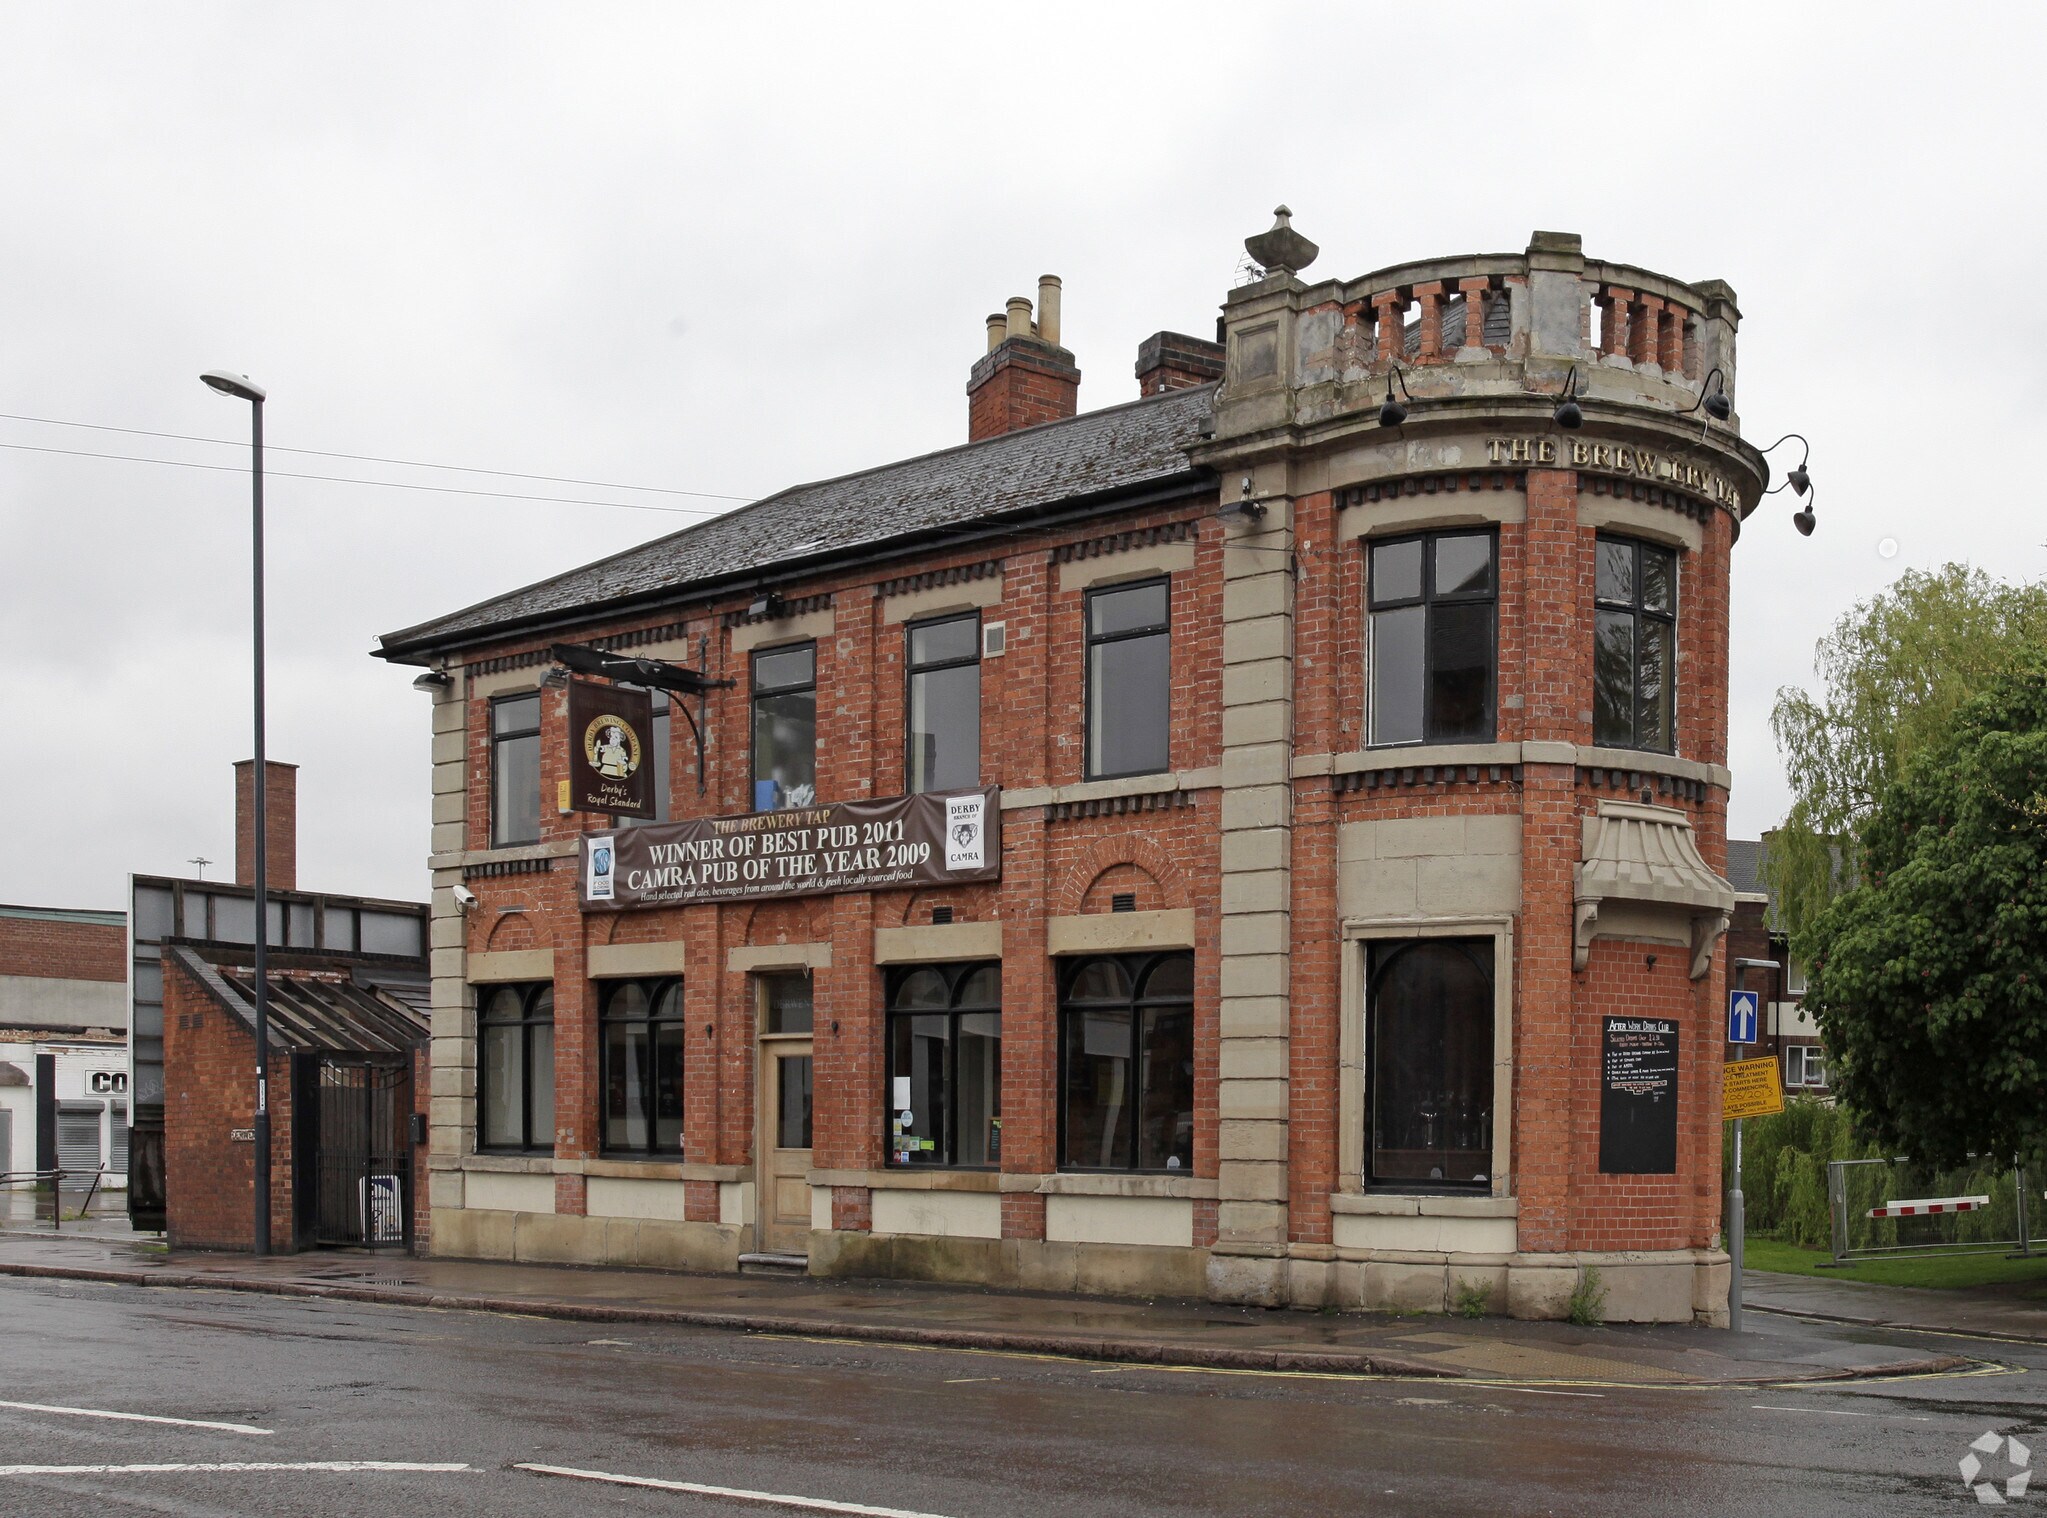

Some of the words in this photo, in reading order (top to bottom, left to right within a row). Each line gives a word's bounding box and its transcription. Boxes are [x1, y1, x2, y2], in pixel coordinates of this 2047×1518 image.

[1488, 438, 1555, 464] THE
[601, 783, 627, 797] Derby's
[587, 793, 608, 807] Royal
[609, 796, 642, 809] Standard
[951, 803, 980, 814] DERBY
[713, 820, 737, 834] THE
[741, 812, 803, 832] BREWERY
[806, 809, 830, 825] TAP
[649, 838, 723, 865] WINNER
[729, 835, 756, 858] OF
[761, 829, 811, 855] BEST
[816, 825, 857, 850] PUB
[863, 819, 905, 845] 2011
[951, 852, 979, 862] CAMRA
[627, 866, 697, 890] CAMRA
[702, 861, 738, 884] PUB
[743, 858, 770, 880] OF
[775, 853, 818, 878] THE
[823, 848, 881, 874] YEAR
[886, 842, 930, 868] 2009
[641, 891, 657, 901] Hand
[658, 889, 682, 900] selected
[683, 888, 696, 898] real
[697, 888, 711, 897] ales,
[713, 886, 742, 896] beverages
[744, 884, 760, 895] from
[760, 881, 784, 892] around
[785, 880, 795, 890] the
[797, 879, 815, 889] world
[817, 879, 823, 887] &
[824, 877, 842, 889] fresh
[843, 874, 867, 885] locally
[868, 871, 895, 882] sourced
[896, 869, 913, 882] food
[1738, 1061, 1774, 1071] WARNING
[92, 1072, 128, 1094] CO
[1729, 1079, 1751, 1087] STARTS
[1735, 1070, 1768, 1080] TREATMENT
[1723, 1087, 1774, 1103] /06/2013
[1728, 1084, 1769, 1094] COMMENCING
